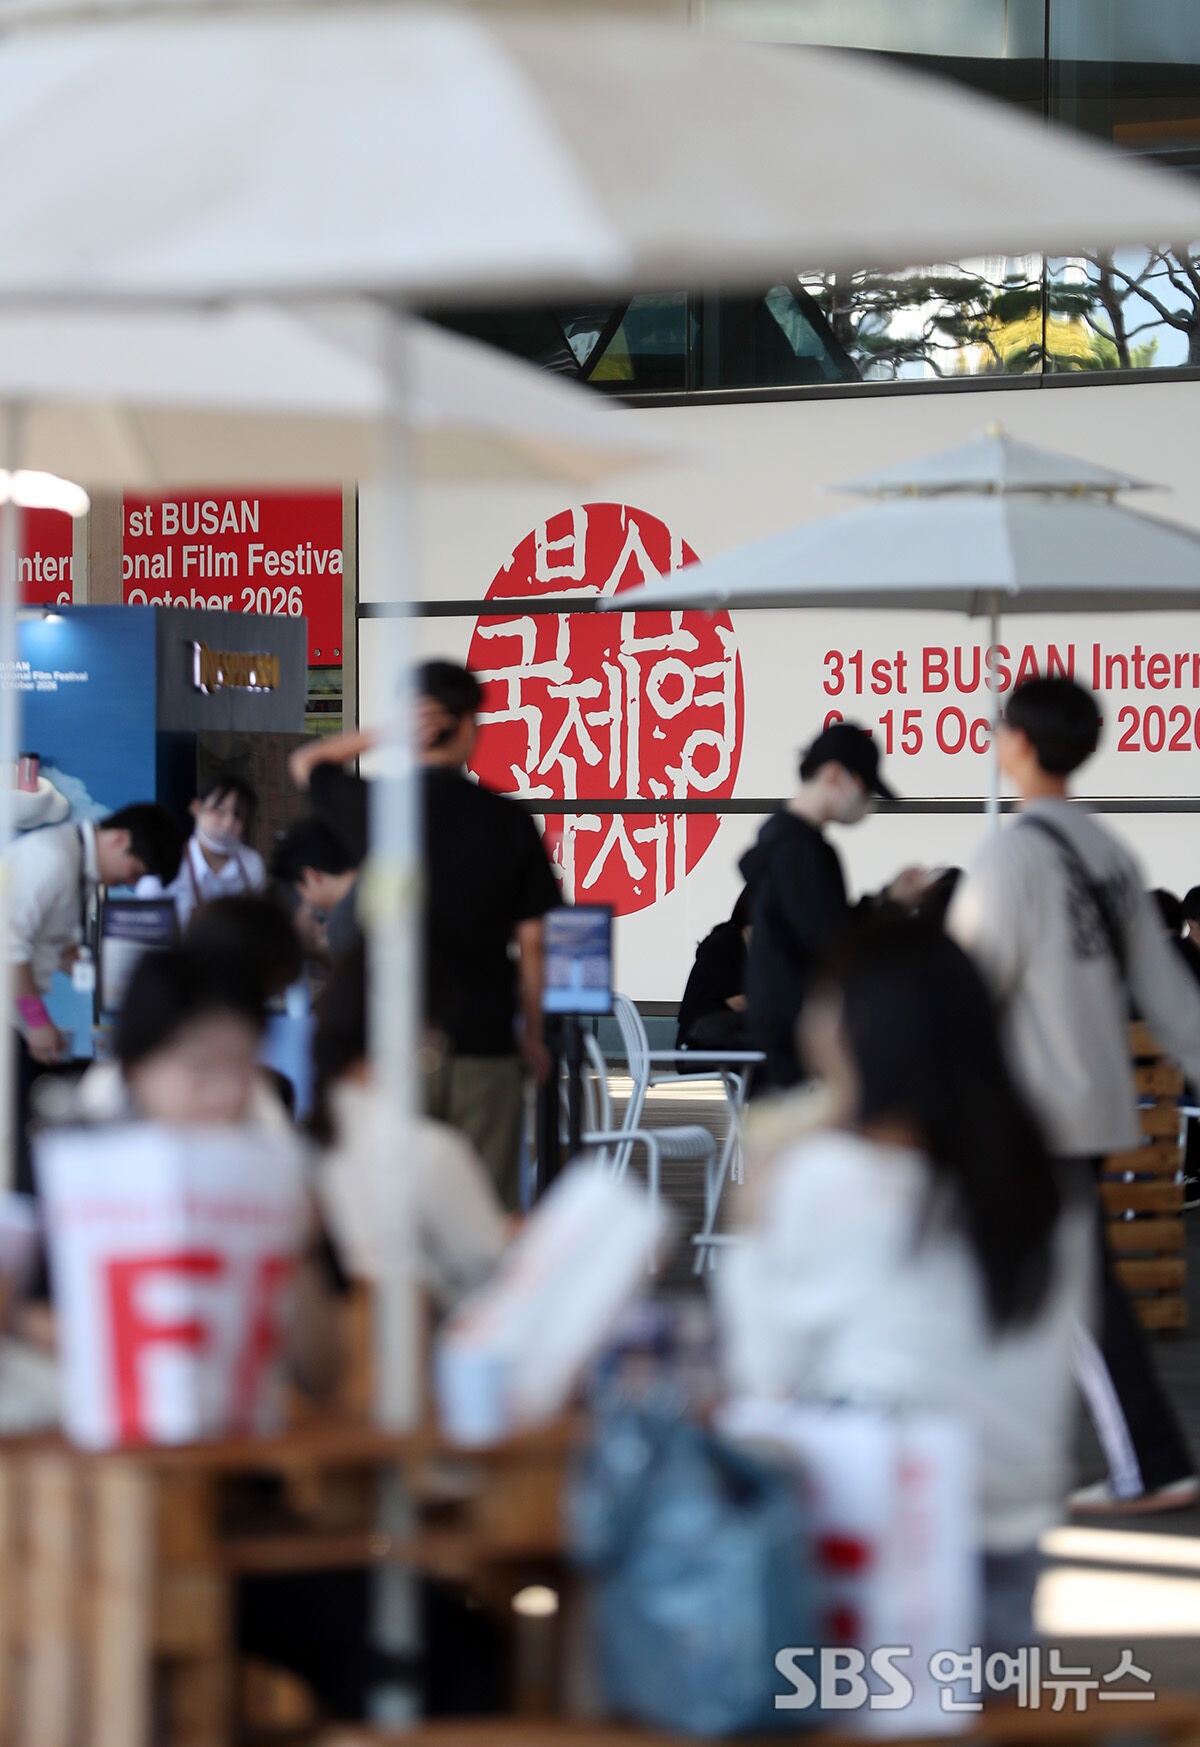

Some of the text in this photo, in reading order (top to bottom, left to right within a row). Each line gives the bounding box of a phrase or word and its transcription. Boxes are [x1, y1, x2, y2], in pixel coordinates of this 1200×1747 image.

[122, 500, 260, 537] st BUSAN
[182, 545, 238, 578] Film
[248, 542, 343, 576] Festiva
[241, 586, 303, 618] 2026
[823, 649, 907, 696] 31st
[922, 644, 1076, 694] BUSAN
[1117, 704, 1200, 753] 202
